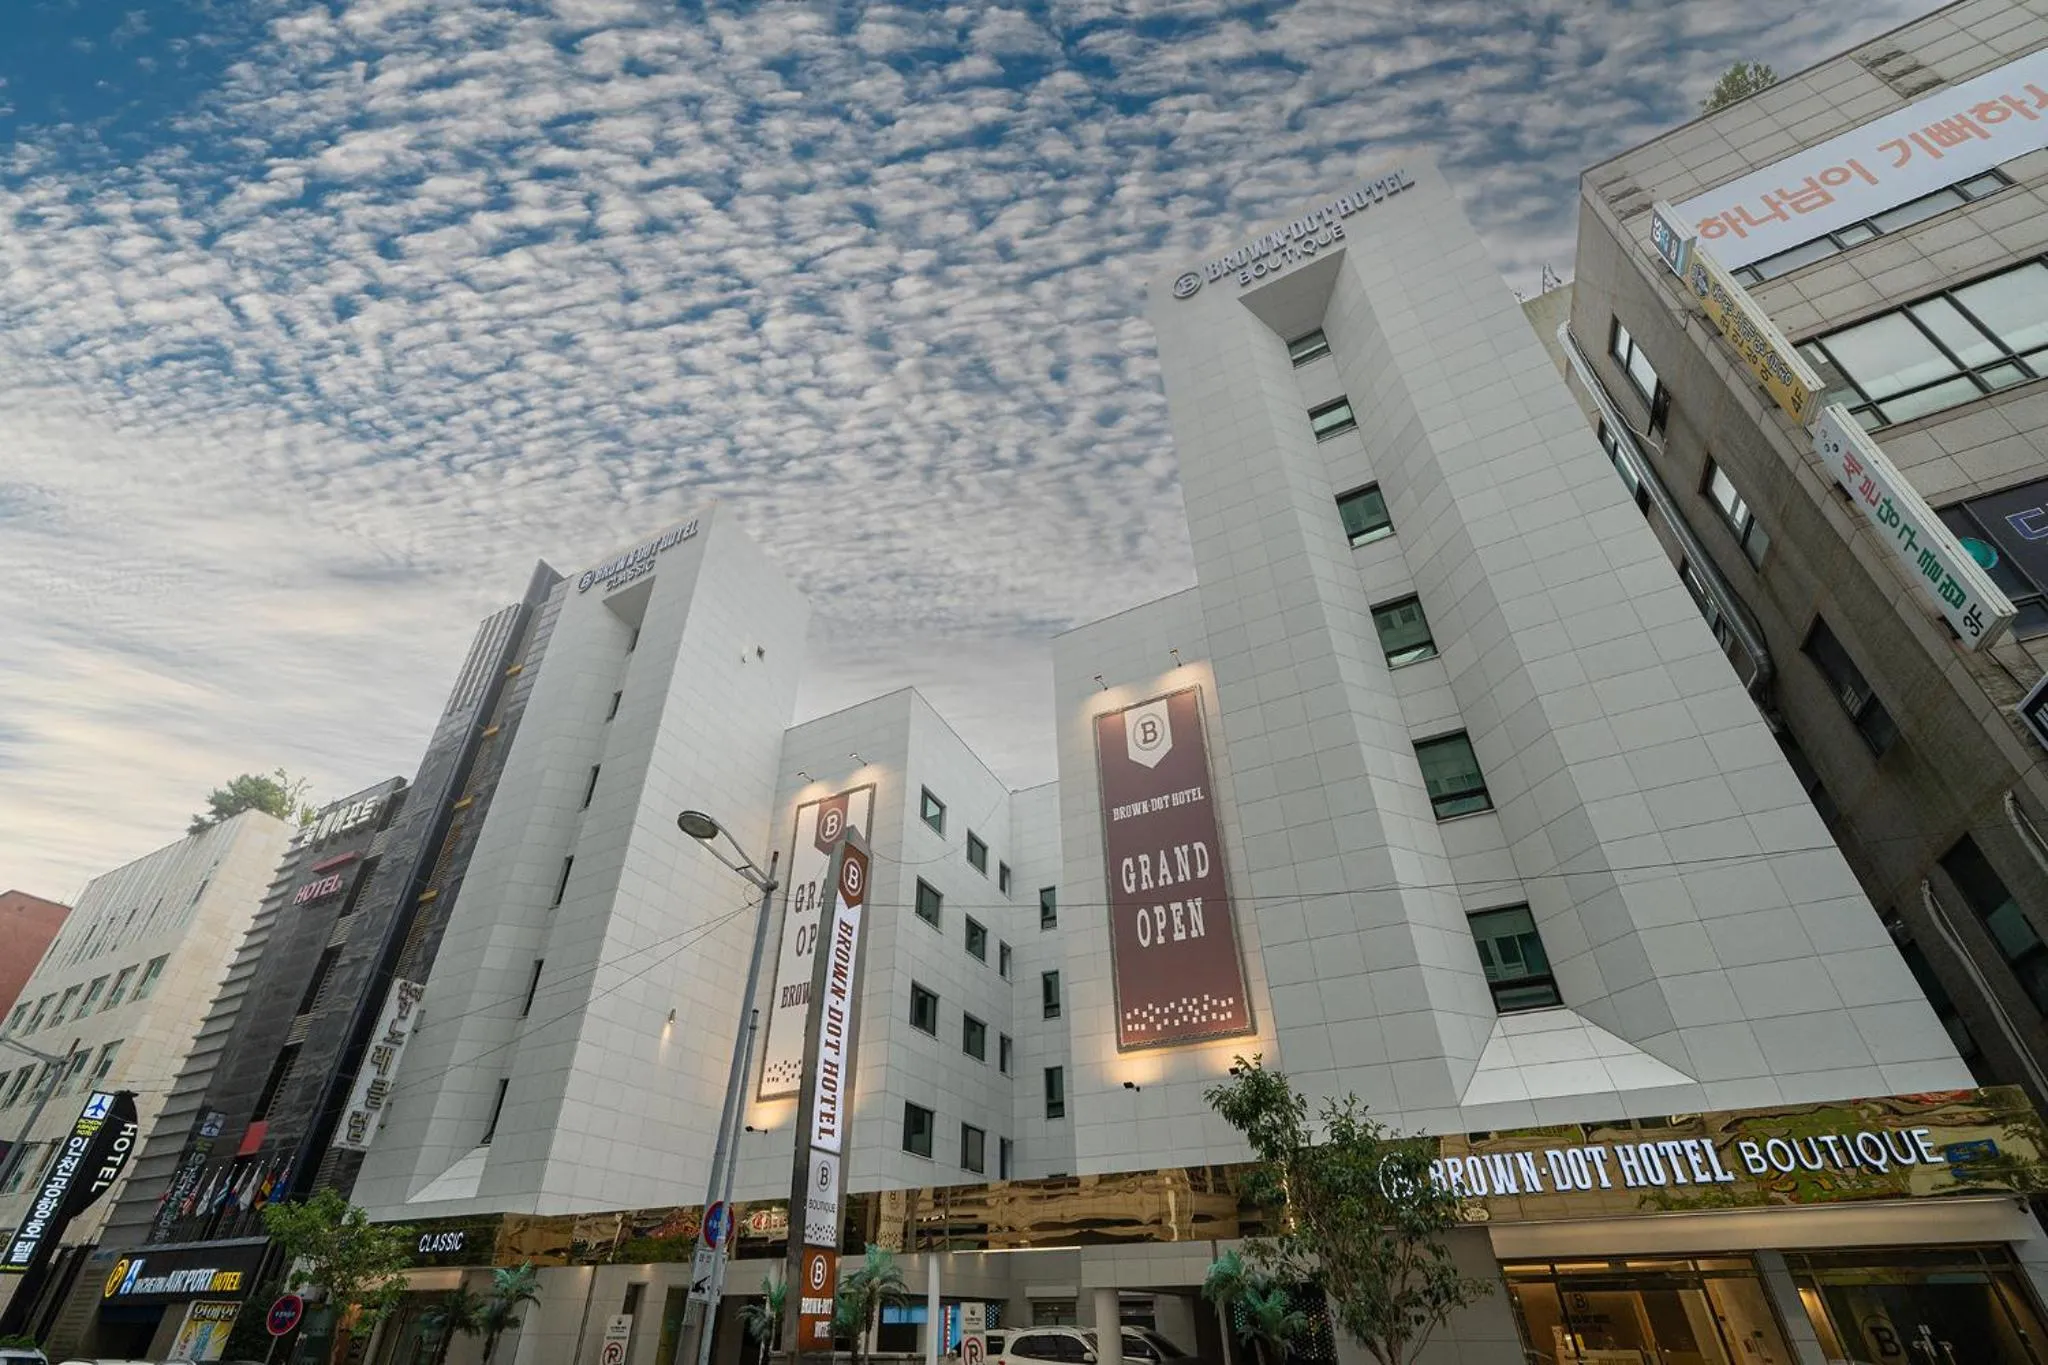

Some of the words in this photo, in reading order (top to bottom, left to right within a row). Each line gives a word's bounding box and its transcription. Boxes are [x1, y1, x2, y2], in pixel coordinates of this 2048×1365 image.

[1339, 170, 1415, 219] HOTEL
[1696, 159, 1879, 239] 하나님이
[1238, 222, 1346, 286] BOUTIQUE
[1963, 602, 1987, 637] 3F
[1141, 721, 1158, 745] B
[1171, 787, 1204, 807] HOTEL
[825, 814, 839, 836] B
[847, 863, 859, 889] B
[1122, 841, 1209, 894] GRAND
[293, 873, 340, 905] HOTEL
[1136, 897, 1204, 948] OPEN
[818, 1059, 841, 1141] HOTEL
[90, 1123, 138, 1193] HOTEL
[1614, 1138, 1735, 1188] HOTEL
[1739, 1128, 1944, 1174] BOUTIQUE
[808, 1200, 836, 1214] BOUTIQUE
[419, 1232, 464, 1252] CLASSIC
[164, 1268, 219, 1293] AIRPORT
[211, 1272, 243, 1291] HOTEL
